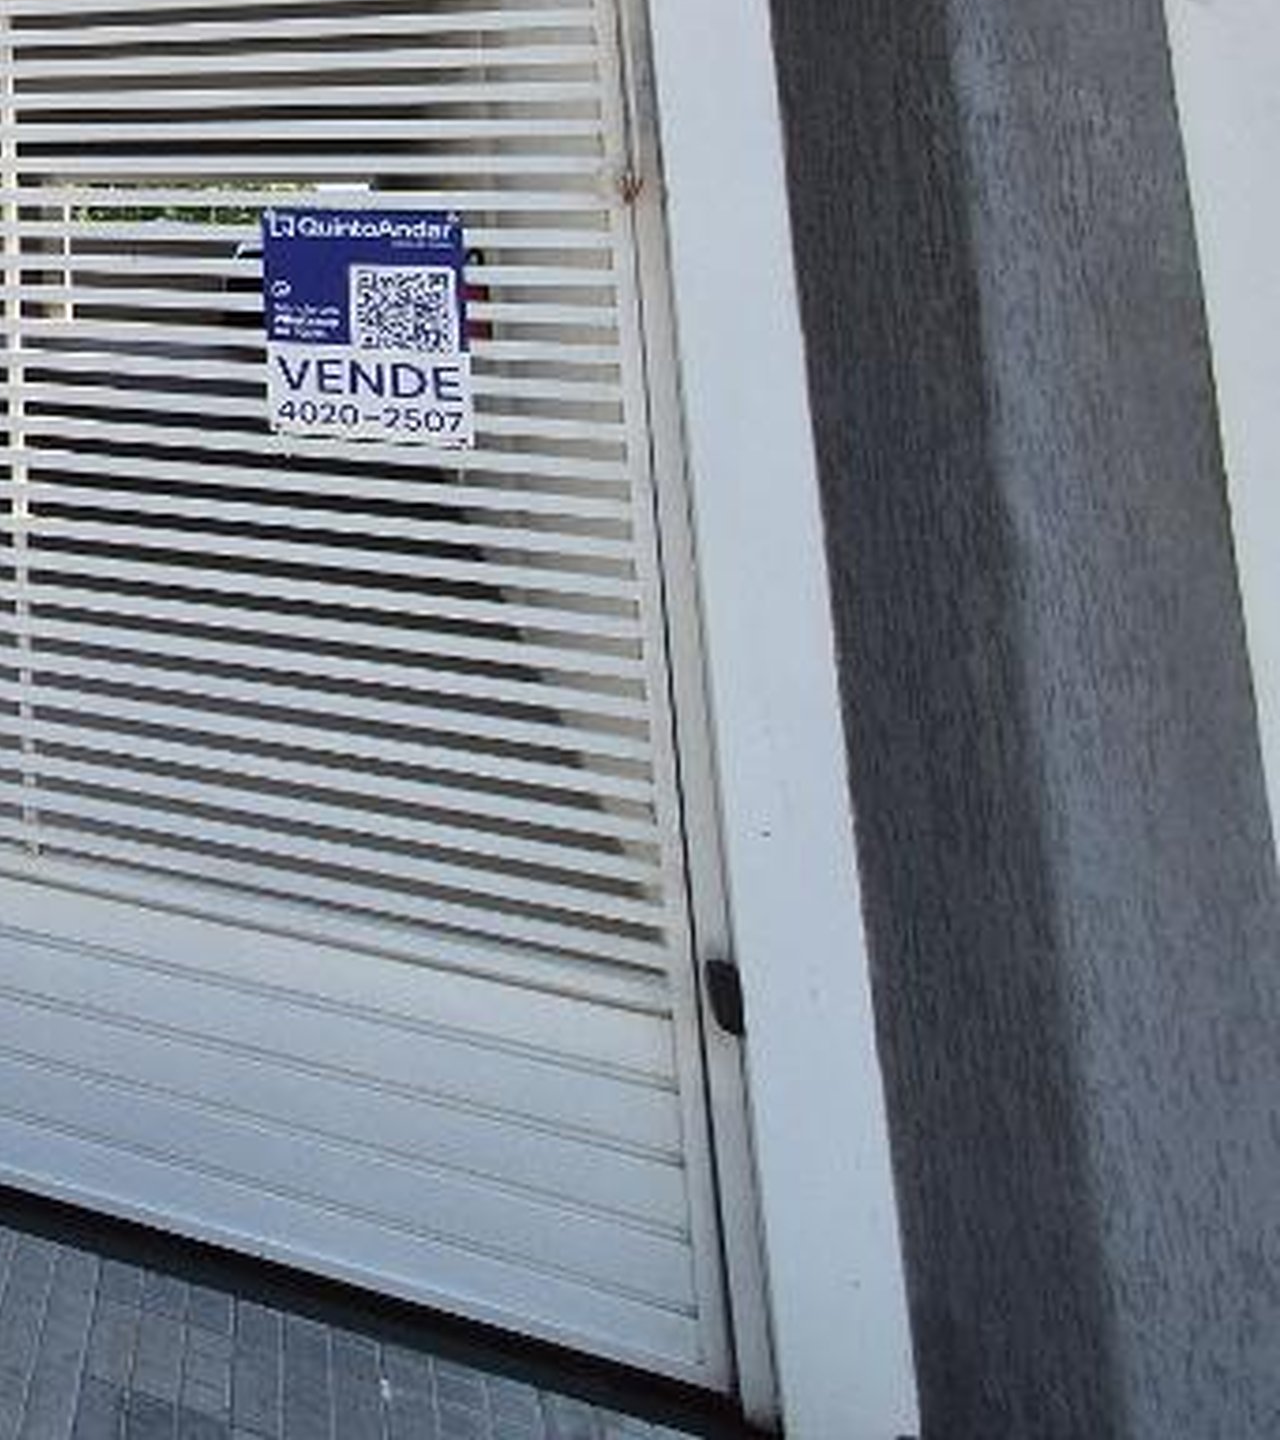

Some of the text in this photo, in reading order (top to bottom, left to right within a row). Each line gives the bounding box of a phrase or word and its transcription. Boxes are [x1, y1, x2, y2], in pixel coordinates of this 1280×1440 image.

[297, 216, 451, 239] QuintoAndar
[277, 356, 463, 402] VENDE
[277, 401, 464, 432] 4020-2507
